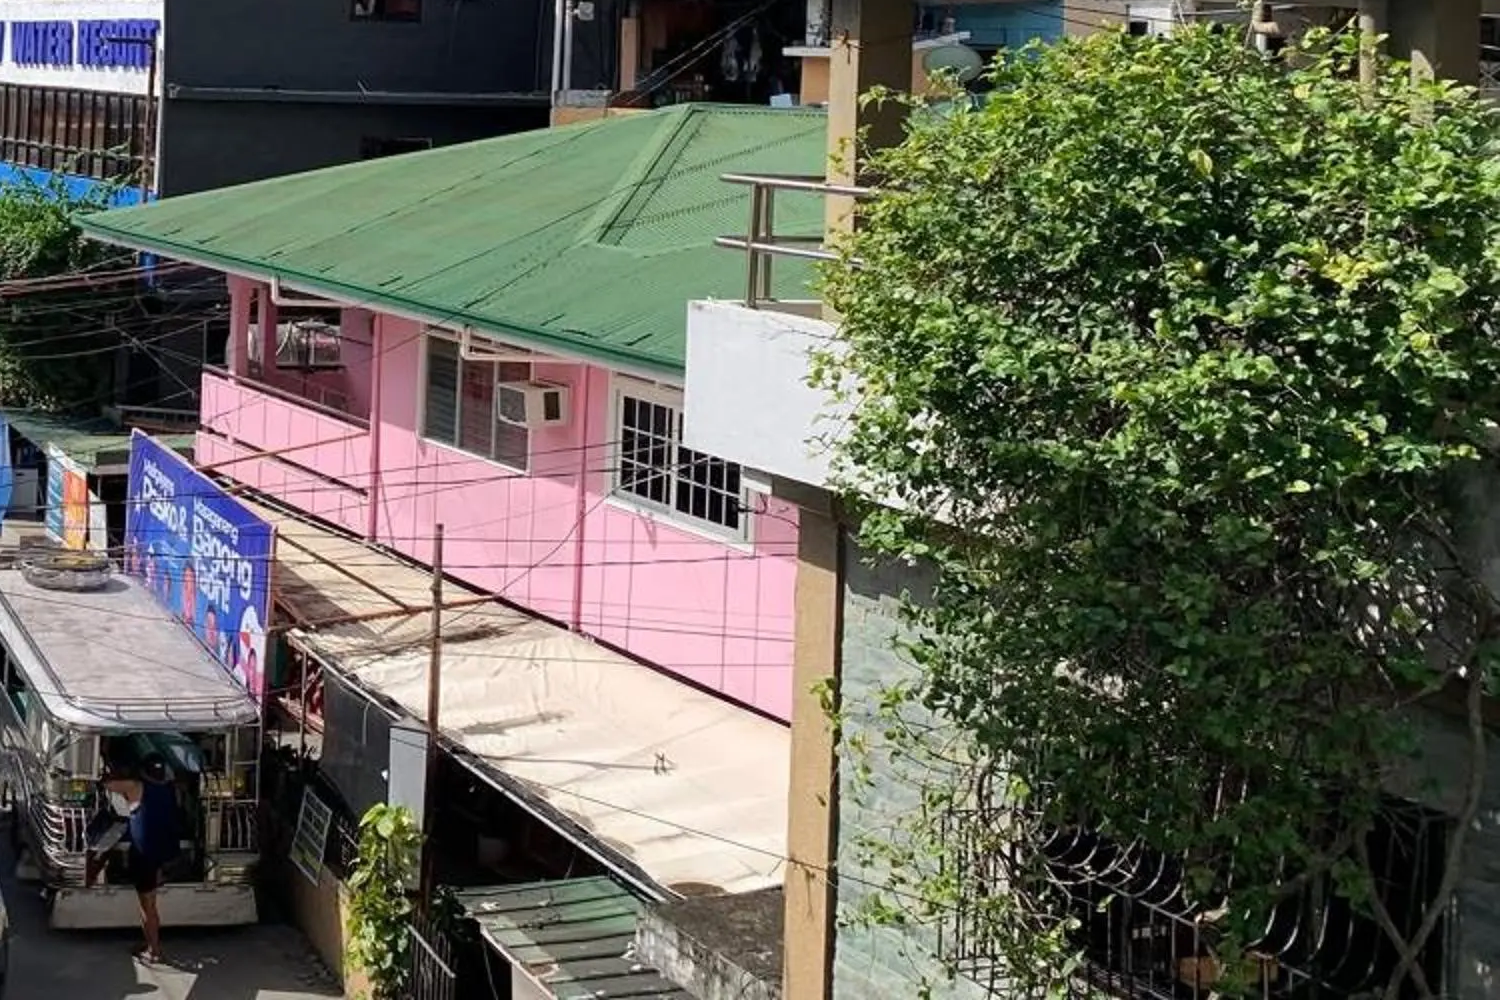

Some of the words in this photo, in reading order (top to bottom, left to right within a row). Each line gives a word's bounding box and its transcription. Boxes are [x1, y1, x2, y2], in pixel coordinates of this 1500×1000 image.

[11, 21, 74, 69] WATER
[77, 19, 160, 72] RESORT
[192, 514, 253, 601] Bagong
